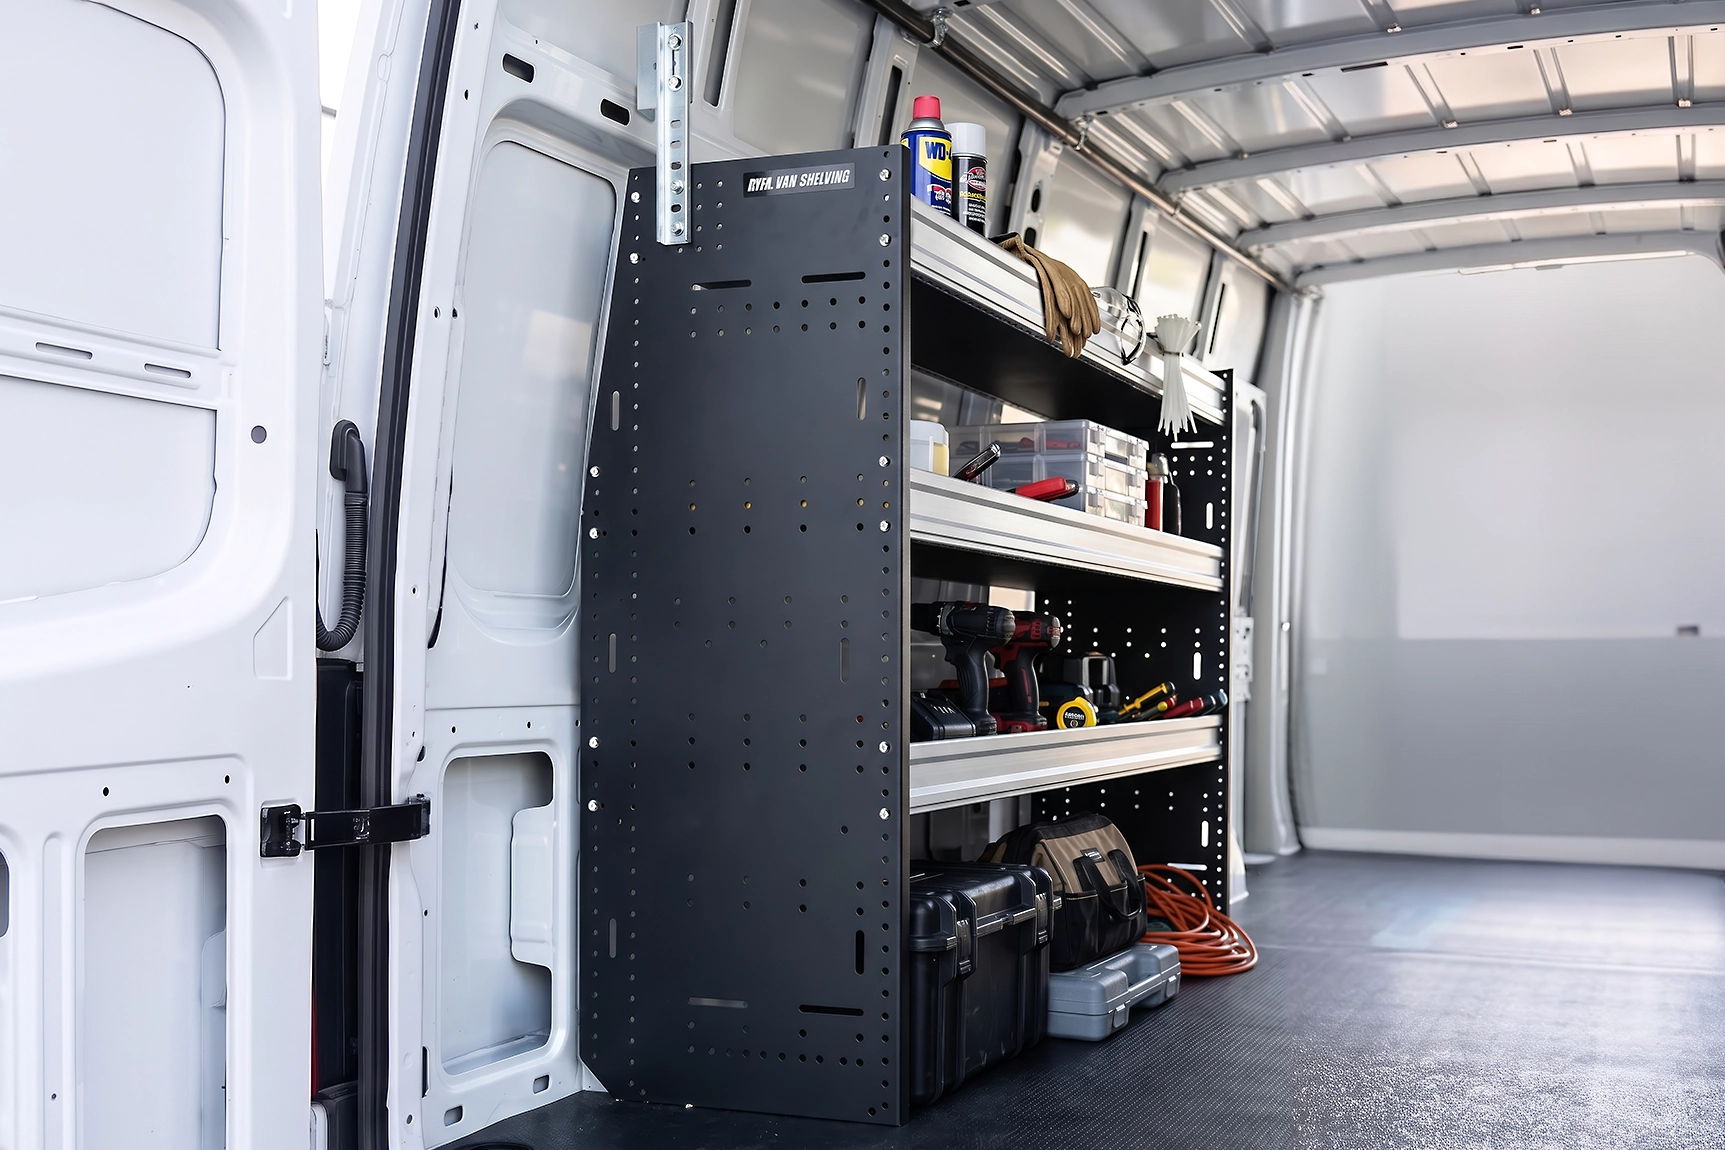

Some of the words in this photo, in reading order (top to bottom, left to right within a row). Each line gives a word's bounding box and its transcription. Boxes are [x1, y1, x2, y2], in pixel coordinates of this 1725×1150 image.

[925, 141, 952, 160] WD-
[775, 174, 797, 189] VAN
[800, 169, 850, 187] SHELVING
